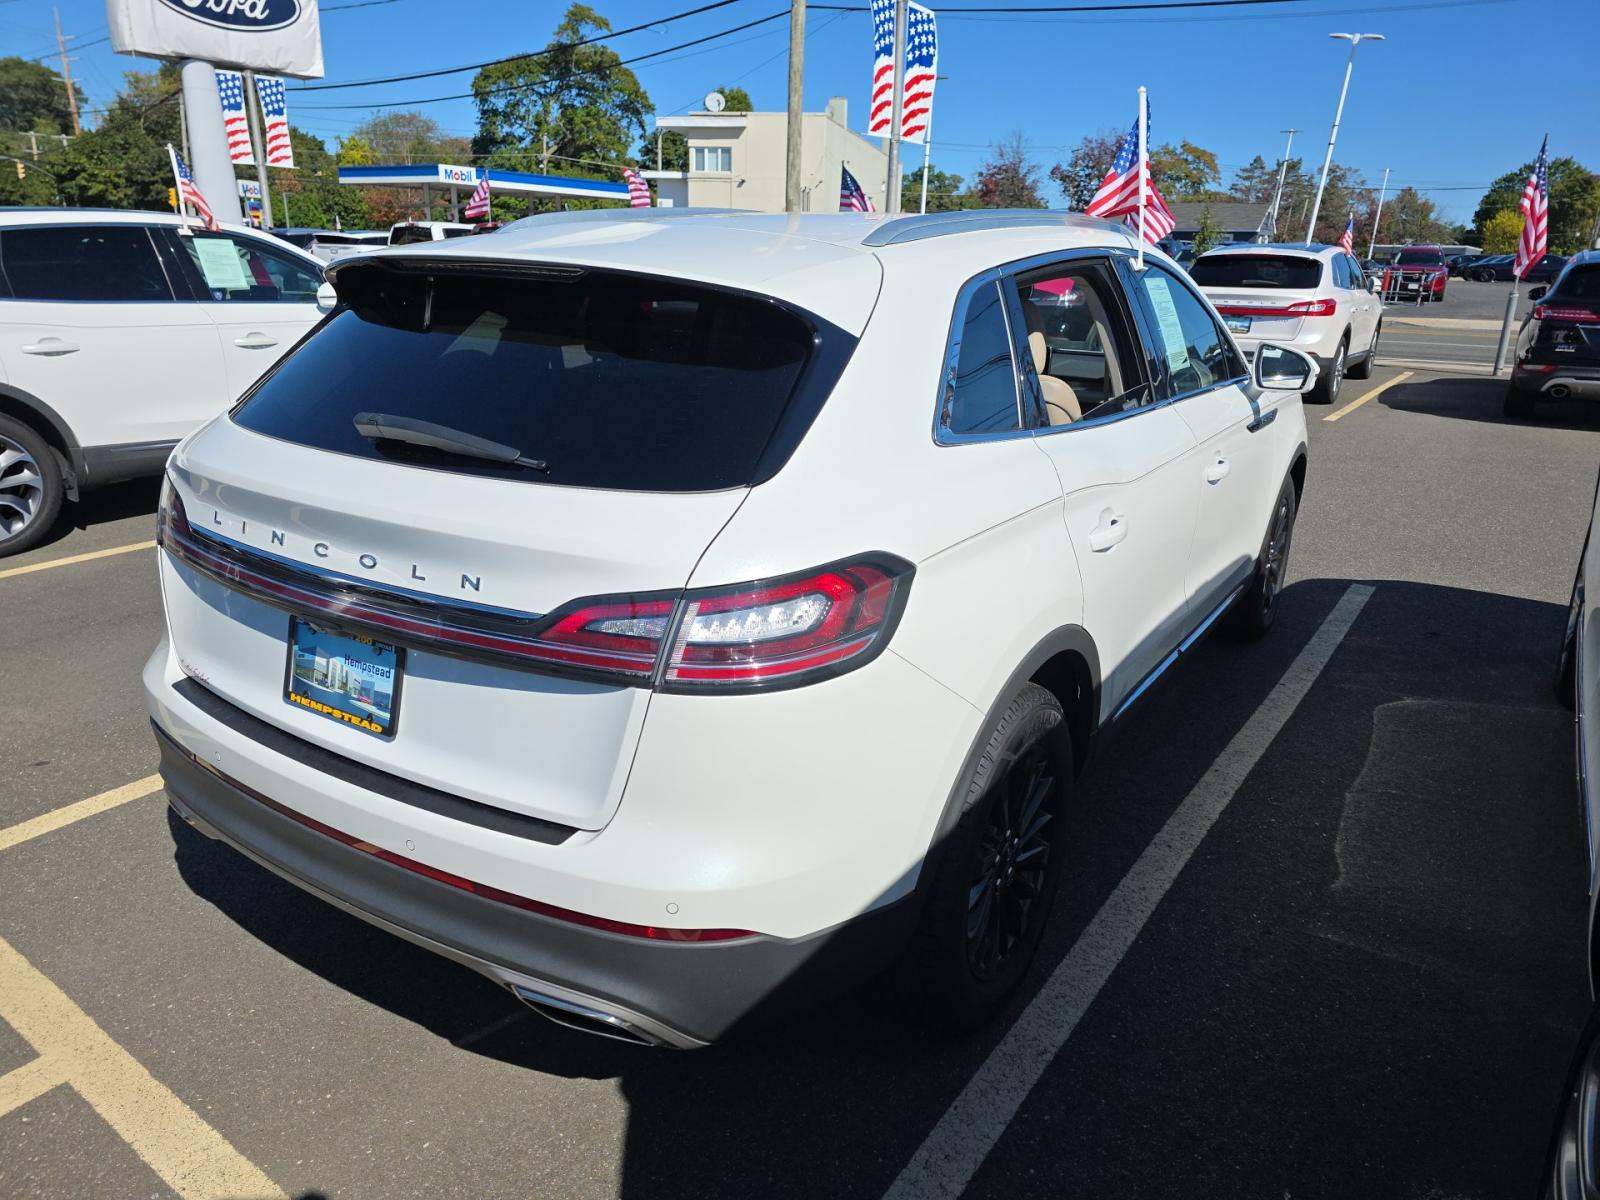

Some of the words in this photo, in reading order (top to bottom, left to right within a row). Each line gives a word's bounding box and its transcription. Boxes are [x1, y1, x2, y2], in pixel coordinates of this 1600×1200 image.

[444, 168, 472, 182] Mobil
[241, 183, 260, 195] Mob
[213, 510, 481, 592] LINCOLN
[344, 653, 392, 679] Hempstead
[289, 692, 384, 733] HEMPSTEAD
